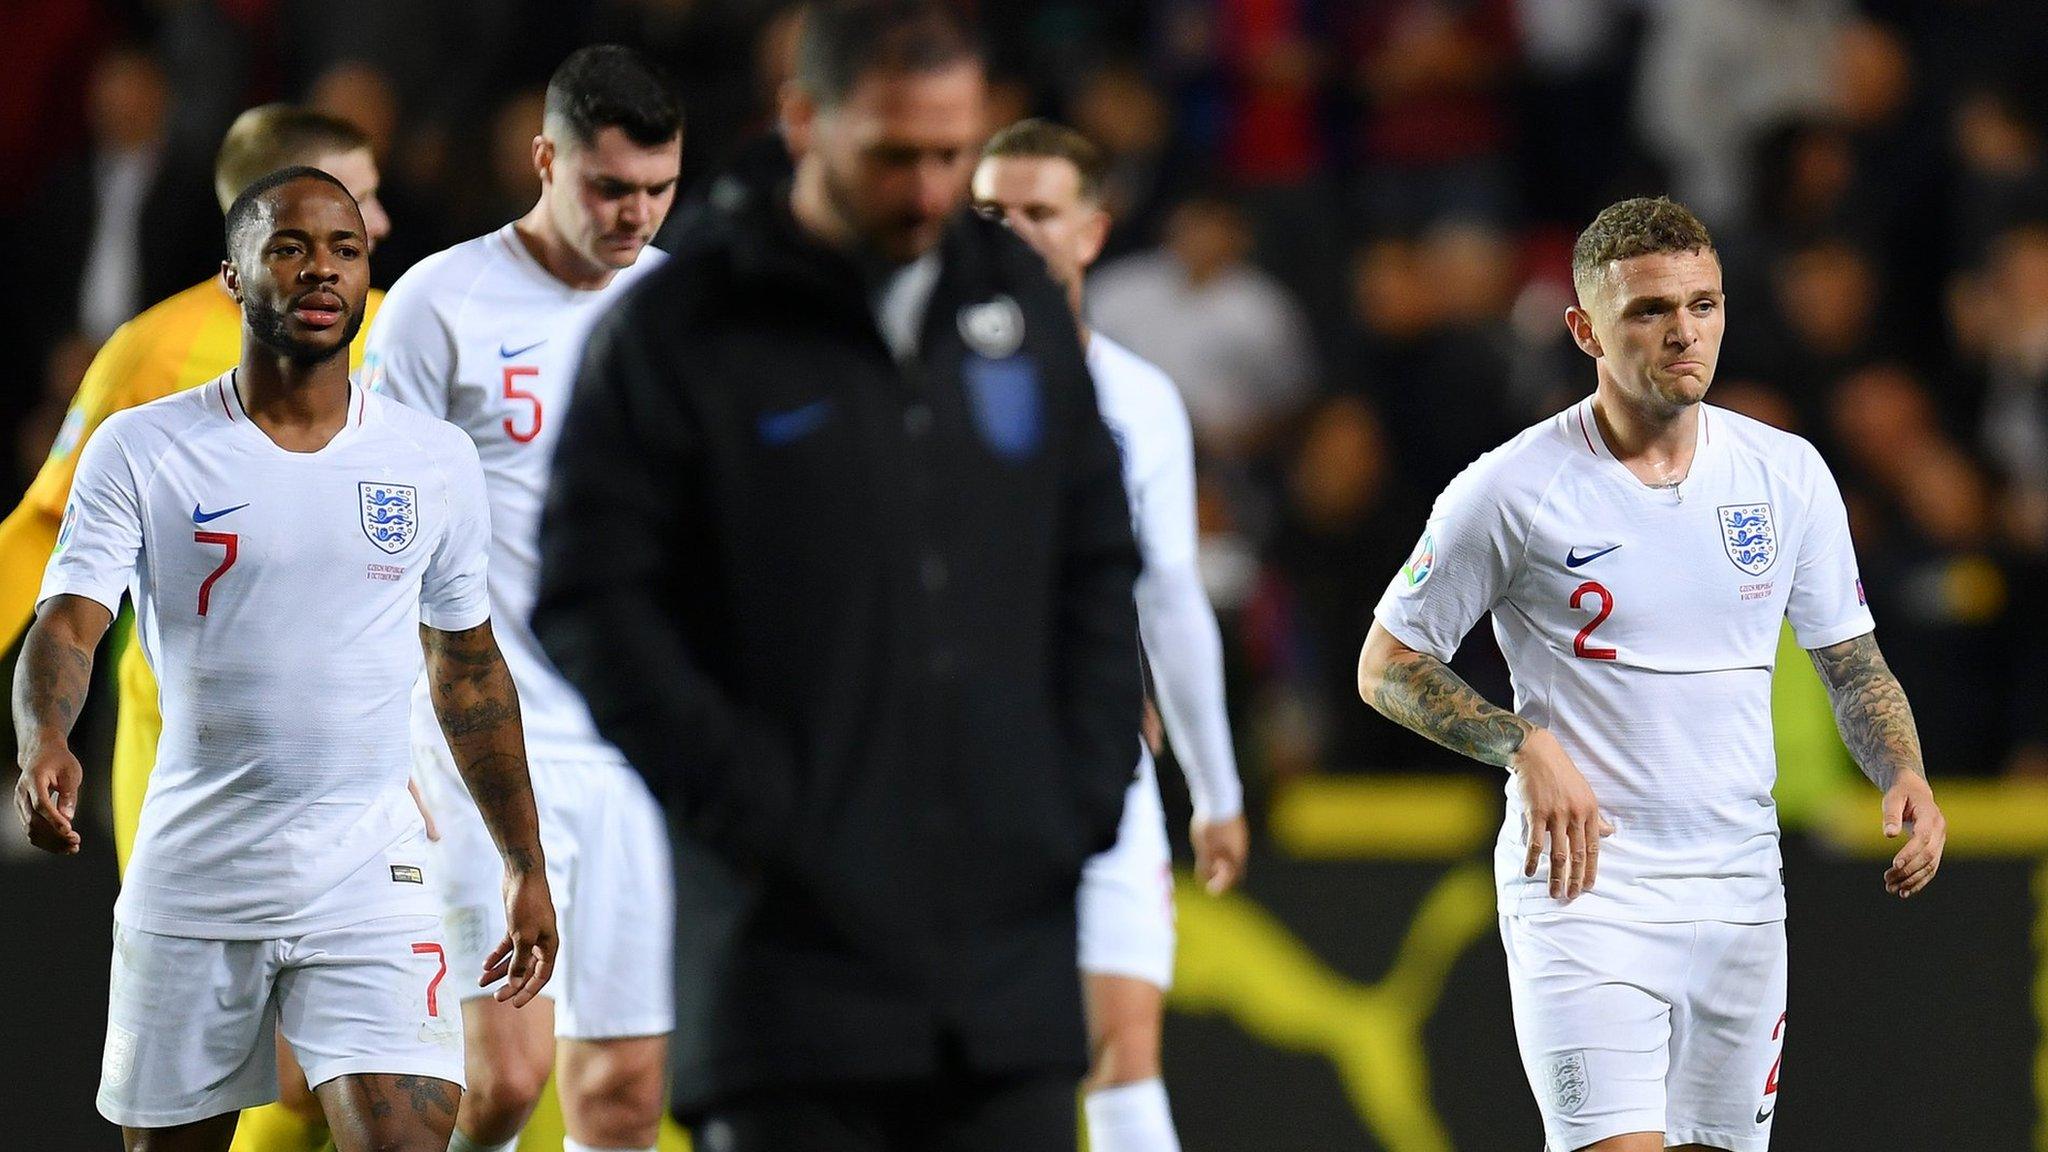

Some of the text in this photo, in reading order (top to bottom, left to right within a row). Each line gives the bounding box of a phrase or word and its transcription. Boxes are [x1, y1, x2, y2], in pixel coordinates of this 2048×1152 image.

[503, 367, 542, 443] 5
[194, 531, 238, 615] 7
[1570, 581, 1617, 660] 2
[411, 942, 447, 1017] 7
